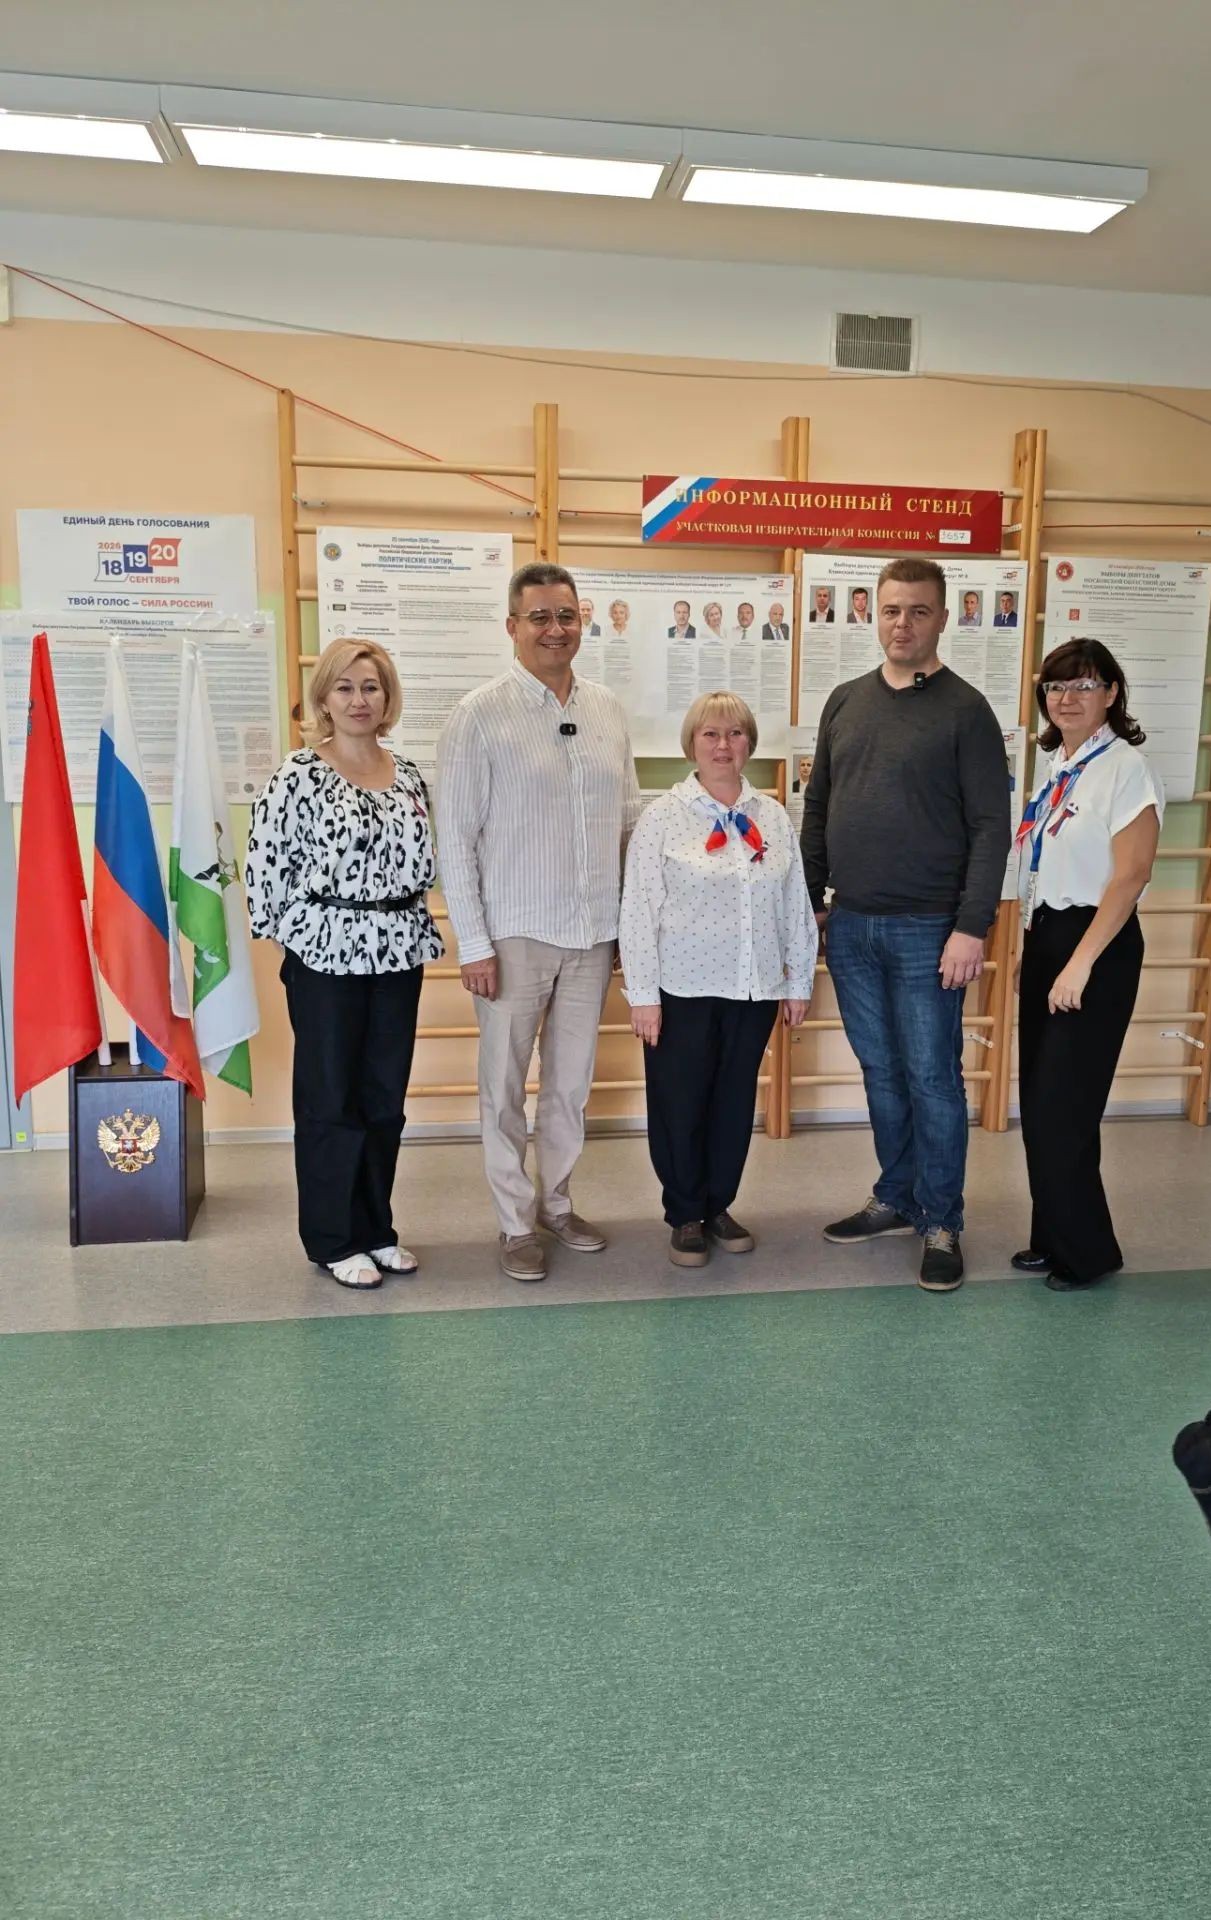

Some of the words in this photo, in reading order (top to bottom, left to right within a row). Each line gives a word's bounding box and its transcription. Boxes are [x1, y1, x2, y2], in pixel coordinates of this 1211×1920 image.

[675, 487, 893, 512] ИНФОРМАЦИОННЫЙ
[906, 497, 973, 517] СТЕНД
[63, 516, 106, 525] ЕДИНЫЙ
[108, 518, 135, 527] ДЕНЬ
[137, 519, 210, 528] ГОЛОСОВАНИЯ
[676, 520, 752, 534] УЧАСТКОВАЯ
[756, 524, 854, 538] ИЗБИРАТЕЛЬНАЯ
[857, 528, 920, 540] КОМИССИЯ
[925, 531, 936, 541] №
[98, 542, 121, 550] 2026
[101, 560, 123, 575] 18
[125, 551, 147, 568] 19
[151, 544, 176, 561] 20
[129, 576, 180, 584] СЕНТЯБРЯ
[68, 596, 95, 606] ТВОЙ
[97, 598, 130, 607] ГОЛОС
[141, 599, 168, 608] СИЛА
[170, 600, 213, 609] РОССИИ!
